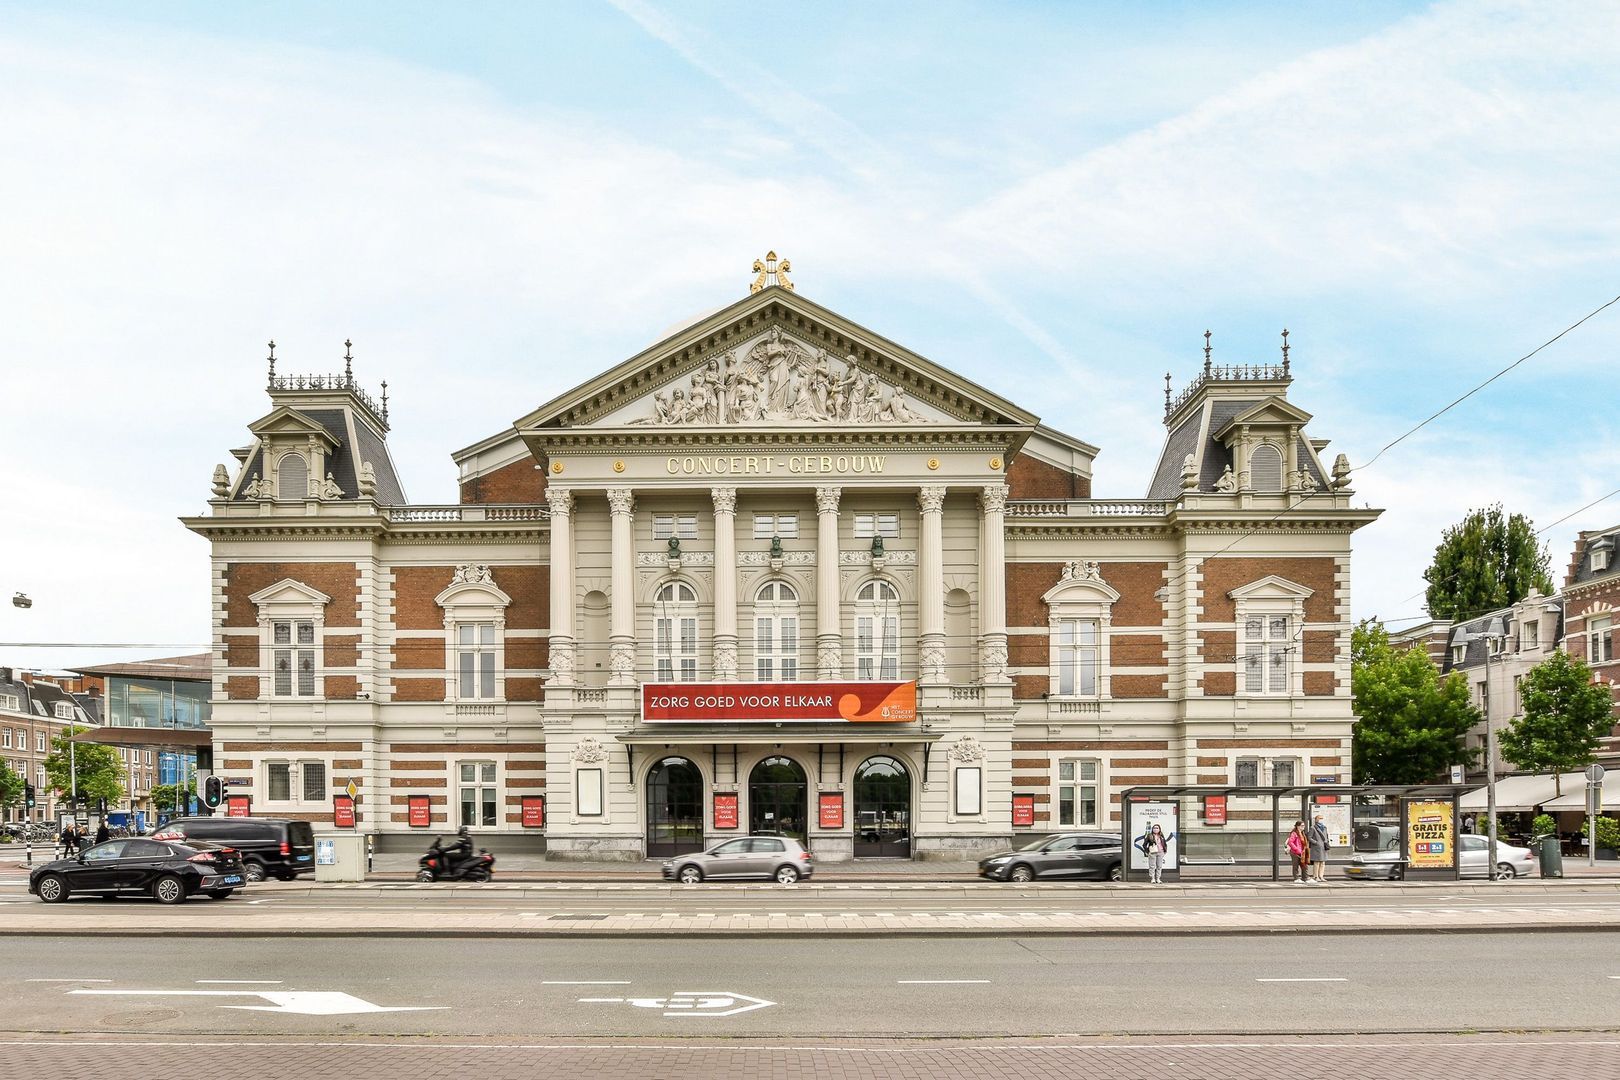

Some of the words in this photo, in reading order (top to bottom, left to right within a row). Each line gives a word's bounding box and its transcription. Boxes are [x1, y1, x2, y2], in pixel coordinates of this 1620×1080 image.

[666, 456, 887, 475] CONCERT-GEBOUW
[650, 696, 690, 708] ZORG
[694, 696, 735, 708] GOED
[739, 695, 780, 708] VOOR
[784, 695, 833, 707] ELKAAR
[1412, 824, 1447, 832] GRATIS
